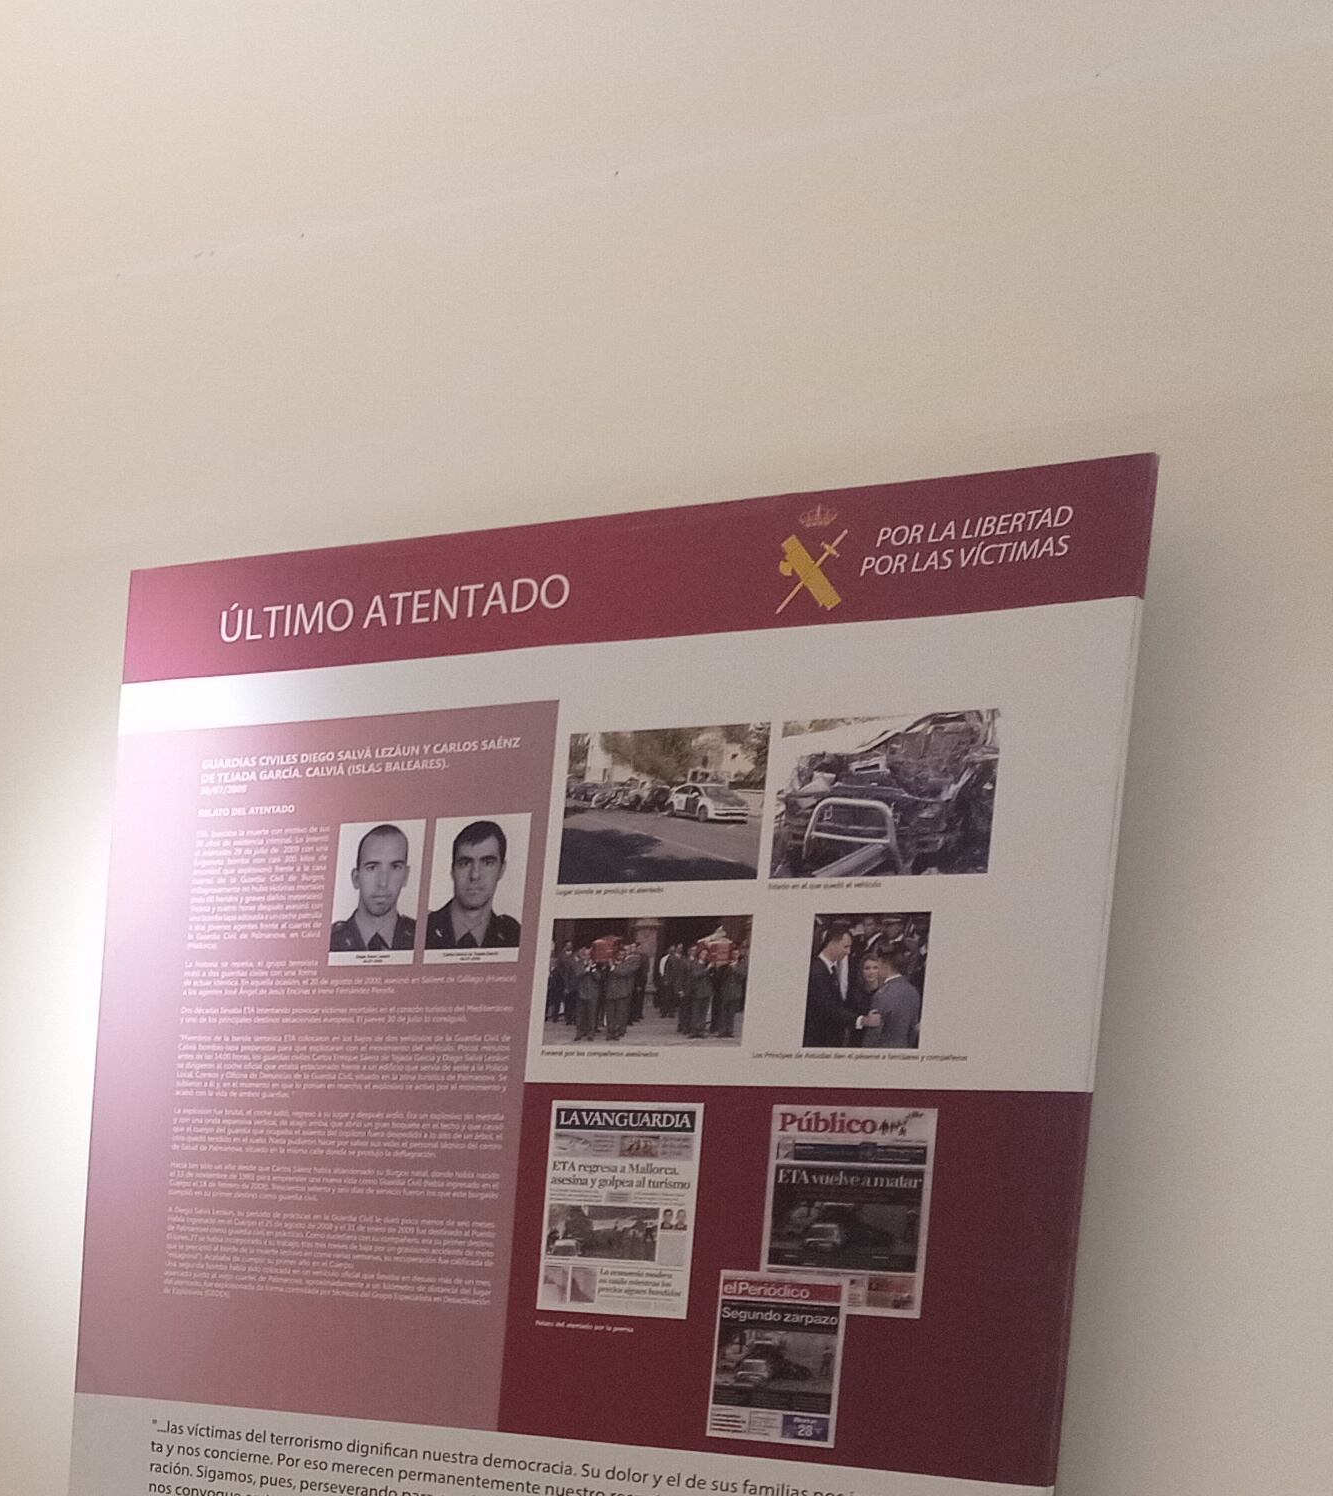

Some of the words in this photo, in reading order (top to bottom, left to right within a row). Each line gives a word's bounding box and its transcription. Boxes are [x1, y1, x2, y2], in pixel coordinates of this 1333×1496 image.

[874, 523, 925, 548] POR
[926, 519, 956, 543] LA
[960, 504, 1074, 540] LIBERTAD
[859, 553, 908, 577] POR
[910, 548, 955, 573] LAS
[959, 534, 1072, 568] VÍCTIMAS
[219, 598, 354, 643] ÚLTIMO
[361, 573, 570, 629] ATENTADO
[559, 1110, 581, 1126] LA
[581, 1110, 692, 1129] VANGUARDIA
[777, 1110, 878, 1135] Público
[551, 1159, 576, 1172] ETA
[577, 1163, 618, 1175] regresa
[776, 1167, 810, 1185] ETA
[810, 1169, 859, 1186] vuelve
[873, 1172, 923, 1189] matar
[549, 1173, 589, 1186] asesina
[596, 1174, 635, 1190] golpea
[634, 1175, 647, 1189] al
[646, 1177, 692, 1190] turismo
[721, 1306, 781, 1325] Segundo
[783, 1312, 839, 1329] zarpazo
[150, 1439, 164, 1453] ta
[176, 1444, 201, 1458] nos
[203, 1447, 274, 1466] concierne.
[276, 1452, 301, 1468] Por
[303, 1458, 329, 1472] eso
[330, 1461, 394, 1479] merecen
[397, 1468, 541, 1495] permanentemente
[186, 1422, 243, 1441] víctimas
[244, 1427, 267, 1444] del
[269, 1431, 344, 1452] terrorismo
[345, 1438, 419, 1460] dignifican
[421, 1449, 479, 1466] nuestra
[481, 1452, 578, 1477] democracia.
[580, 1462, 601, 1479] Su
[604, 1464, 650, 1484] dolor
[684, 1473, 707, 1490] de
[709, 1479, 738, 1494] sus
[147, 1482, 172, 1495] nos
[149, 1461, 194, 1477] ración.
[195, 1463, 257, 1486] Sigamos,
[258, 1474, 297, 1491] pues,
